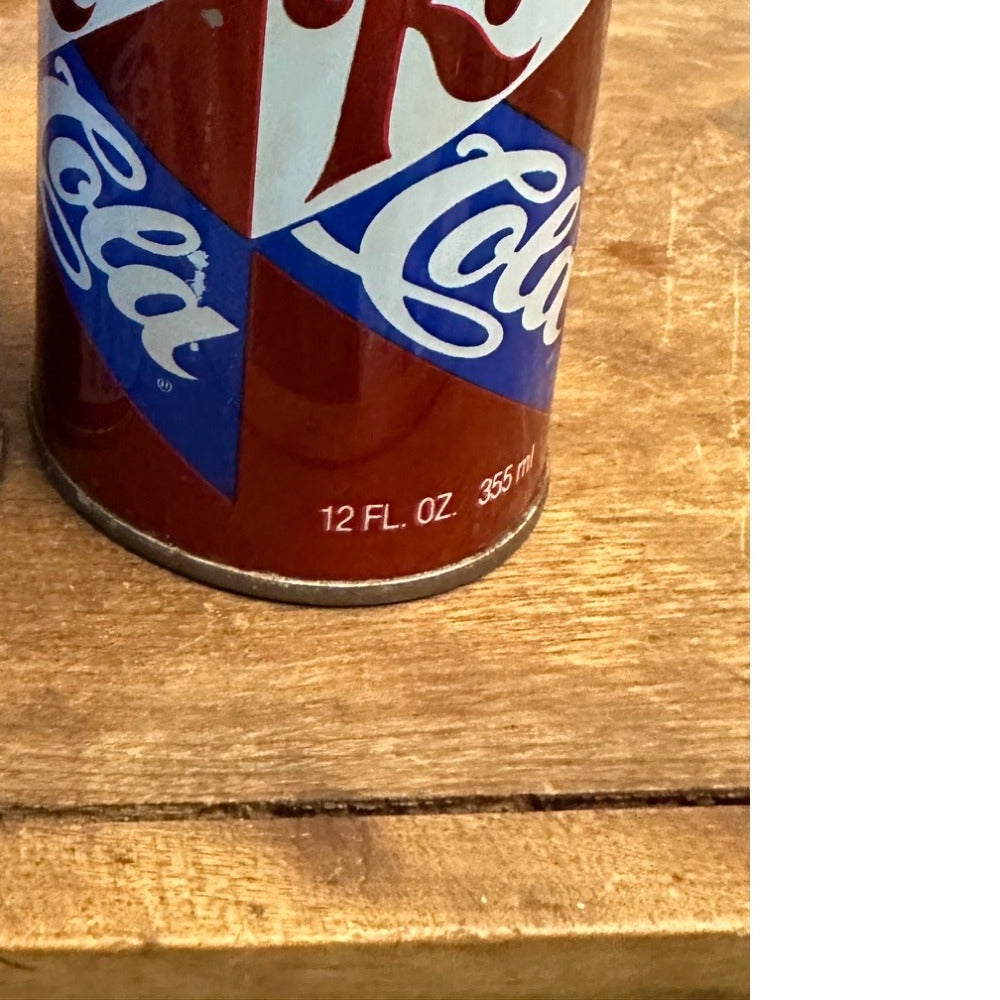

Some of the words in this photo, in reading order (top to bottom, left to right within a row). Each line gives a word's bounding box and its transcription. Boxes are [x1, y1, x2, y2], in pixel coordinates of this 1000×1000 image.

[41, 56, 240, 380] Cola
[319, 505, 355, 532] 12
[362, 503, 407, 532] FL.
[416, 491, 457, 525] OZ.
[478, 464, 513, 506] 355
[515, 443, 536, 482] ml
